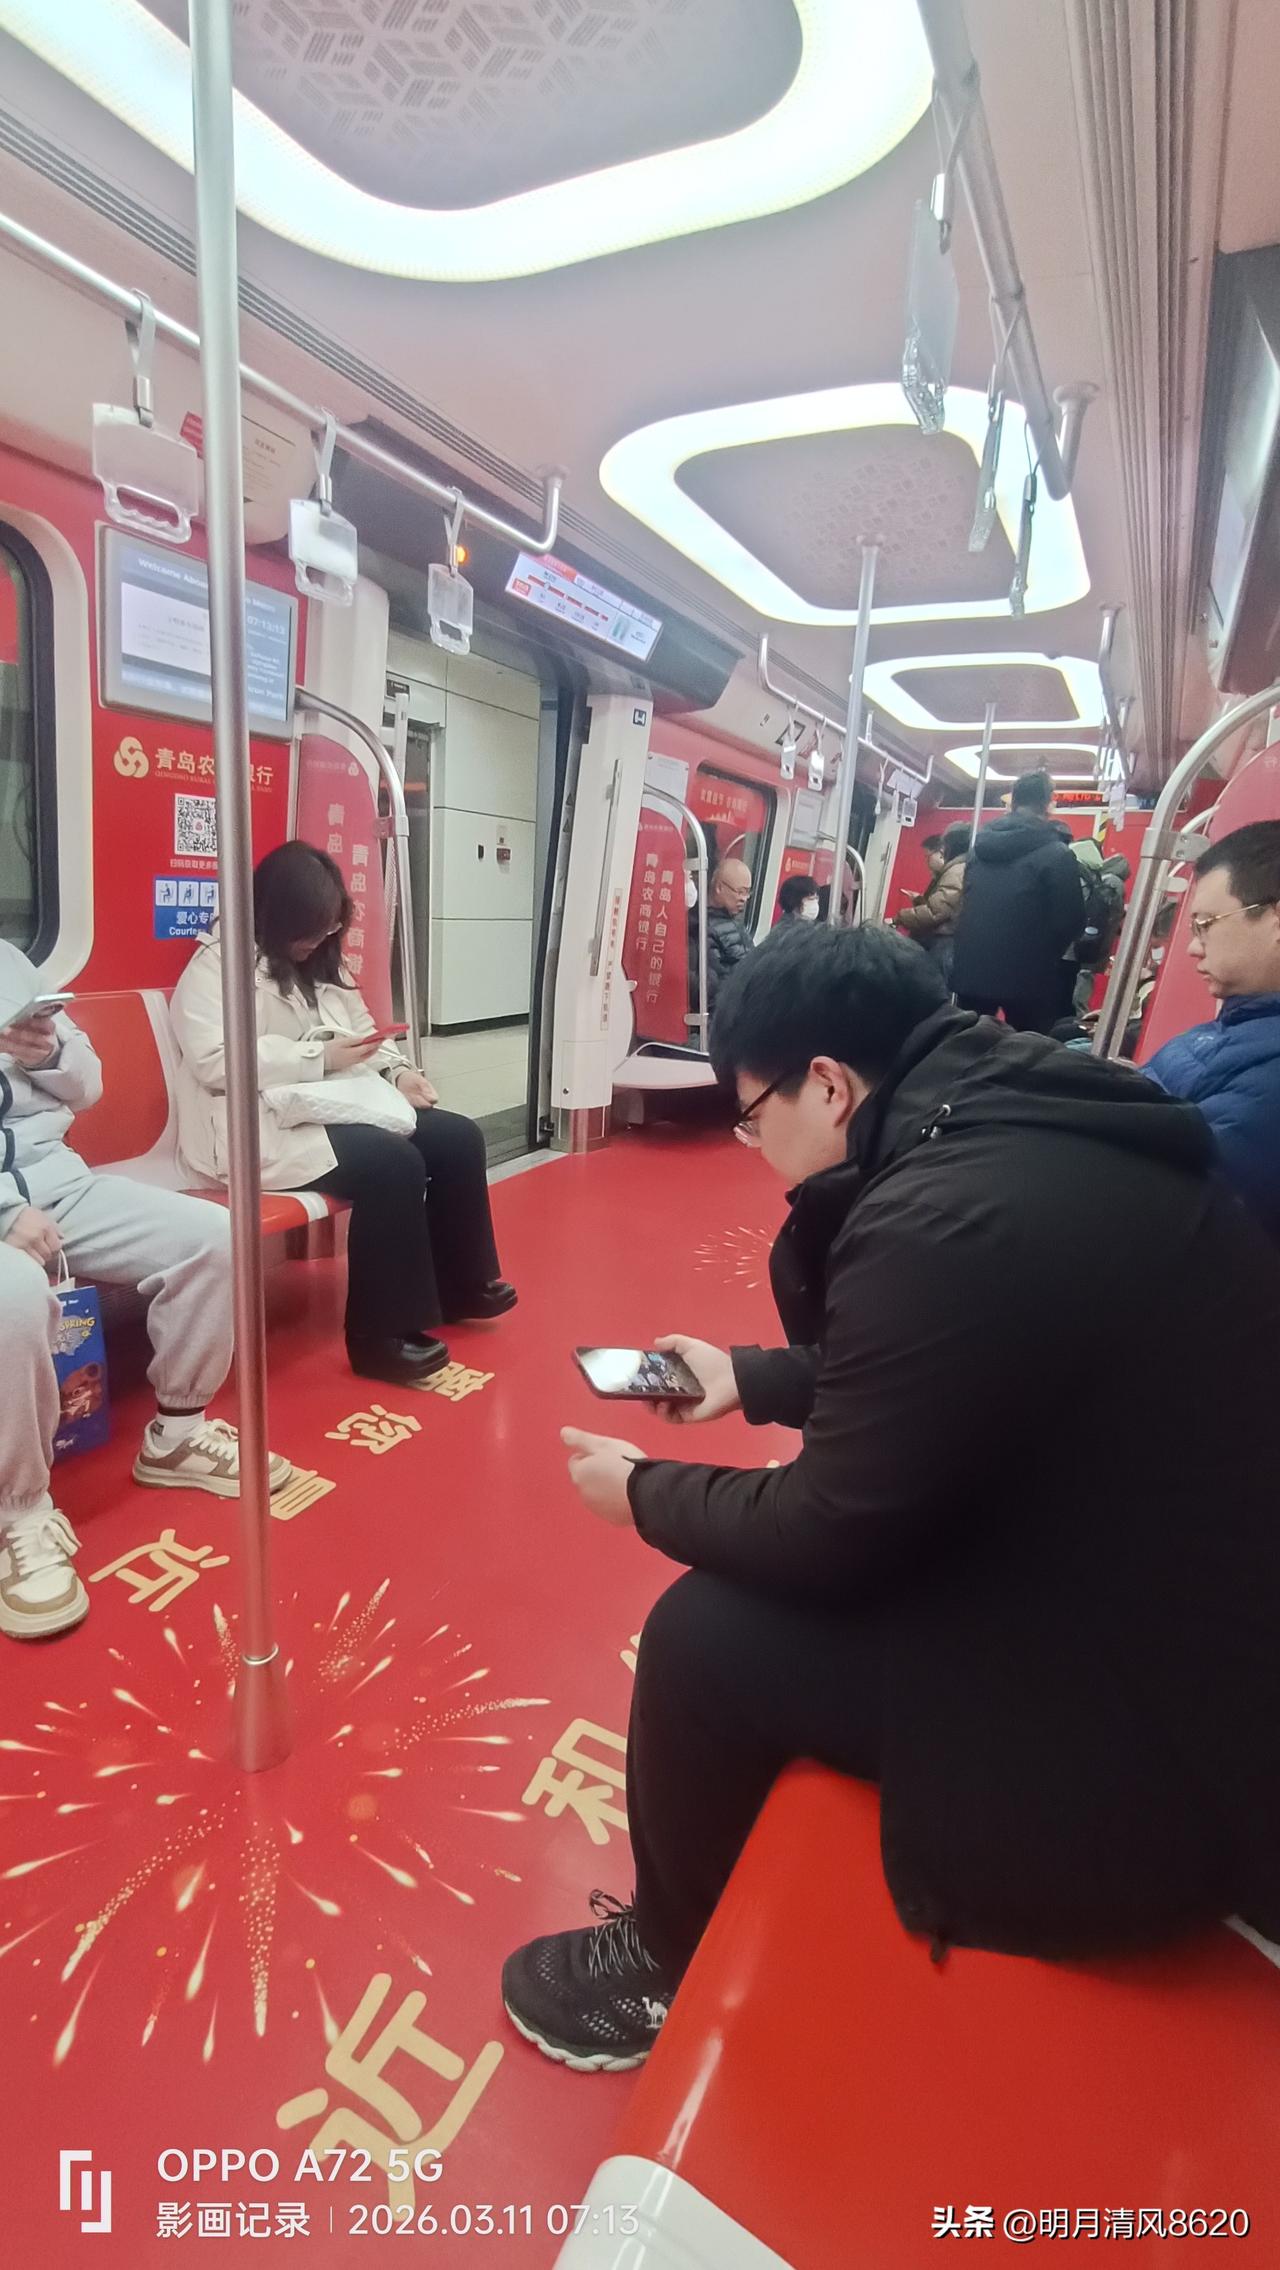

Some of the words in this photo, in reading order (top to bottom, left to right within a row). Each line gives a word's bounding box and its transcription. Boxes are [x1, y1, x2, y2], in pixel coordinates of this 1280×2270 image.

[635, 852, 659, 951] 青岛农商银行
[646, 870, 674, 1004] 青岛人自己的银行
